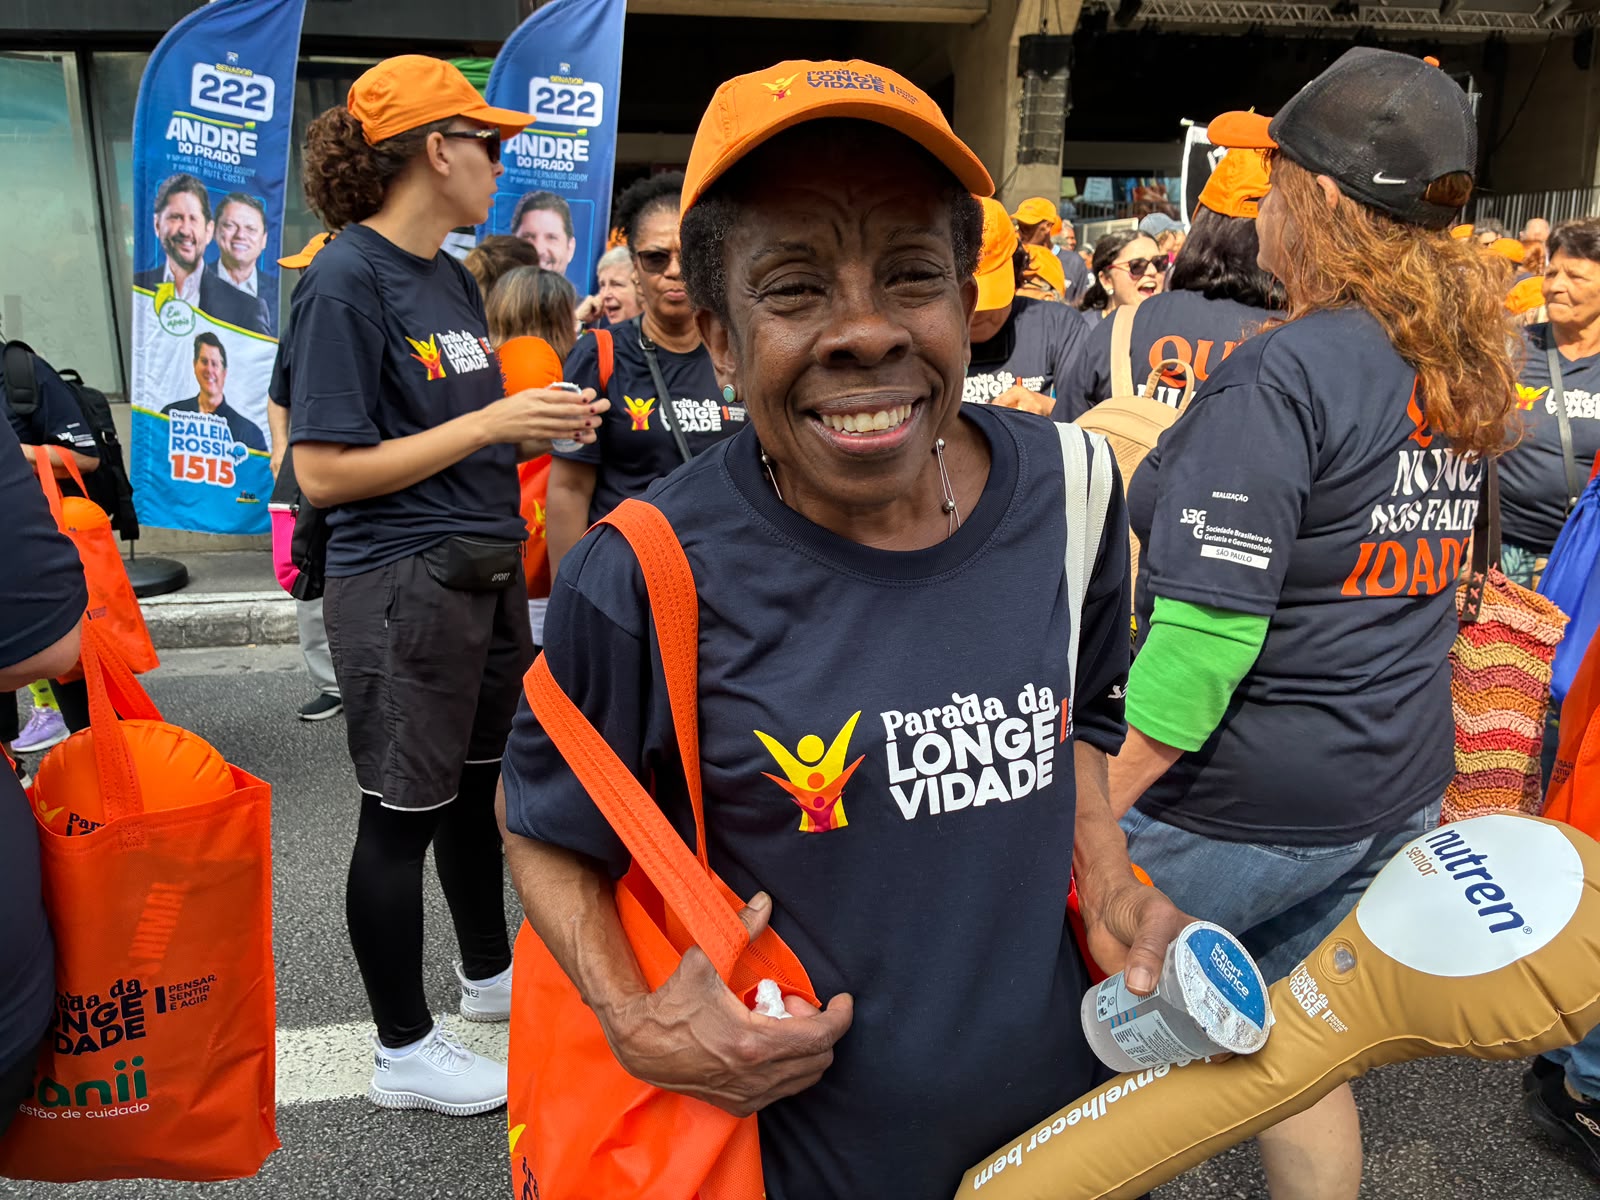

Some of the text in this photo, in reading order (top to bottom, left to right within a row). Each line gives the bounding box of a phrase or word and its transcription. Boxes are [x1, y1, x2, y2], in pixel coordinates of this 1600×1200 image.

[807, 75, 884, 86] LONGE
[807, 81, 885, 94] VIDADE
[199, 73, 267, 112] 222
[536, 87, 596, 118] 222
[178, 141, 194, 156] DO
[194, 146, 240, 165] PRADO
[516, 156, 532, 168] DO
[533, 158, 574, 172] PRADO
[443, 338, 484, 360] LONGE
[450, 353, 490, 374] VIDADE
[172, 420, 232, 443] BALEIA
[172, 436, 226, 457] ROSSI
[172, 454, 234, 484] 1515
[1212, 491, 1249, 502] REALIZAÇÃO
[1368, 500, 1422, 535] NOS
[1204, 534, 1228, 543] Geriatria
[1232, 538, 1272, 554] Gerontologia
[1206, 525, 1272, 544] Sociedade Brasileira de
[1216, 548, 1252, 562] SÃO PAULO
[1341, 538, 1469, 596] IDAD
[880, 692, 1007, 742] Parada
[1017, 682, 1060, 716] da
[886, 712, 1056, 784] LONGE
[889, 749, 1054, 820] VIDADE
[69, 812, 105, 831] Par
[1406, 846, 1438, 876] senior
[1215, 942, 1244, 978] smart
[168, 974, 218, 994] PENSAR
[1210, 948, 1250, 997] balance
[56, 978, 148, 1012] ada da
[169, 984, 210, 1002] SENTIR
[170, 994, 208, 1010] E AGIR
[1289, 977, 1316, 1018] VIDADE
[1294, 971, 1324, 1014] LONGE
[1318, 993, 1328, 1008] da
[62, 1108, 81, 1119] de
[85, 1103, 150, 1118] cuidado
[973, 1062, 1170, 1191] envelhecer bem
